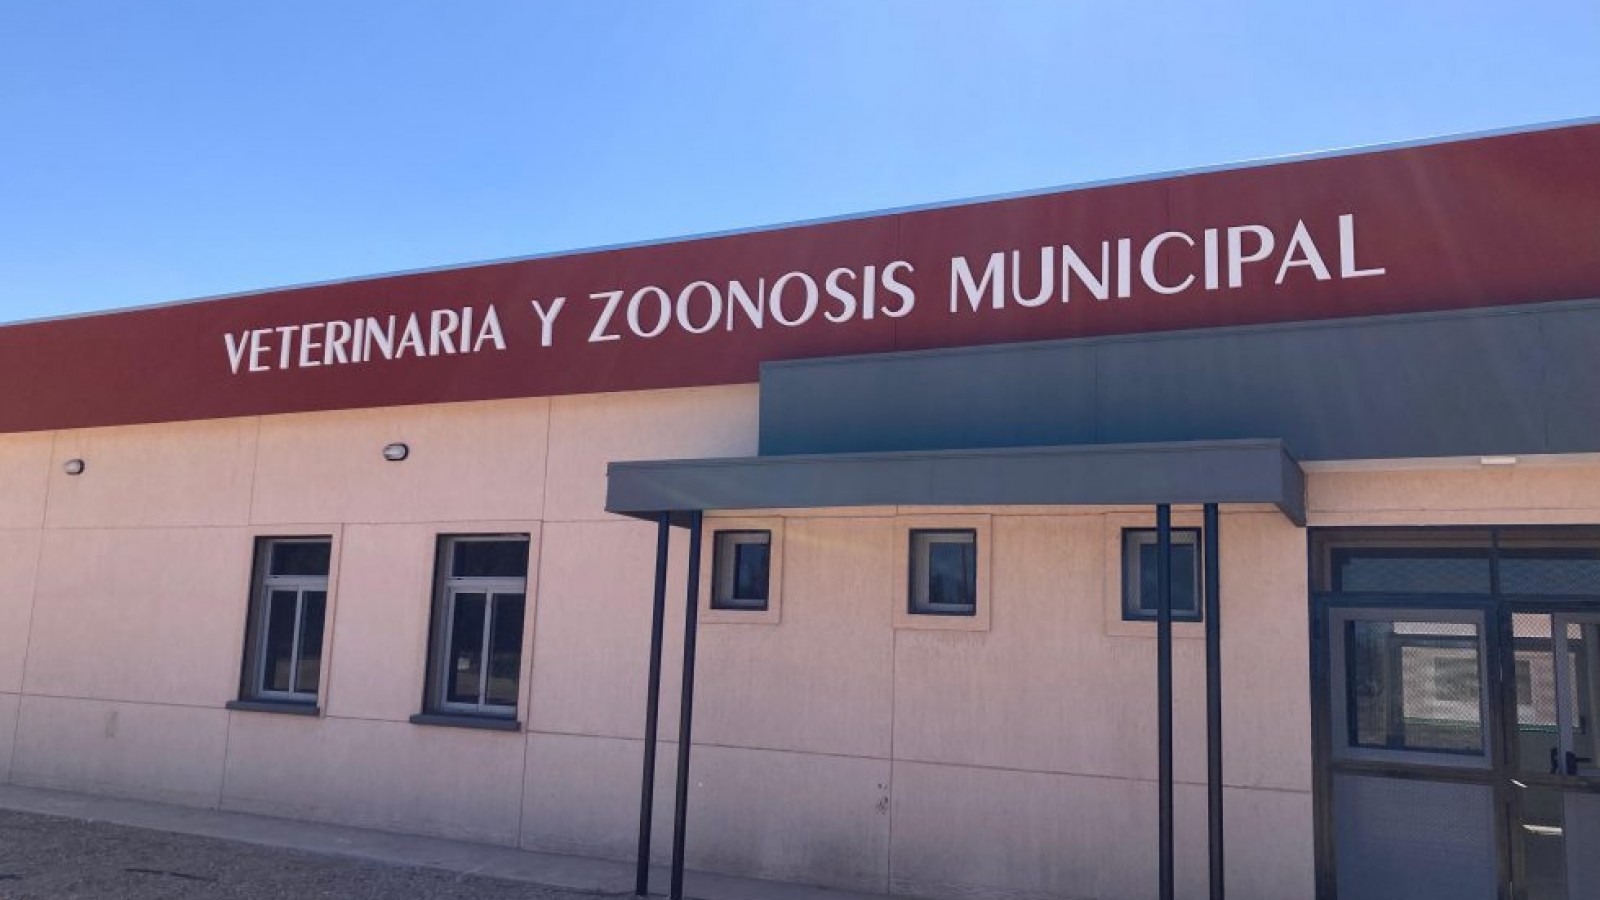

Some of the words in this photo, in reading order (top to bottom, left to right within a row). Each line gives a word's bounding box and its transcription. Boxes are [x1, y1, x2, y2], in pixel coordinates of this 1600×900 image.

[224, 304, 506, 374] VETERINARIA
[532, 297, 565, 347] Y
[588, 260, 916, 342] ZOONOSIS
[951, 213, 1386, 313] MUNICIPAL
